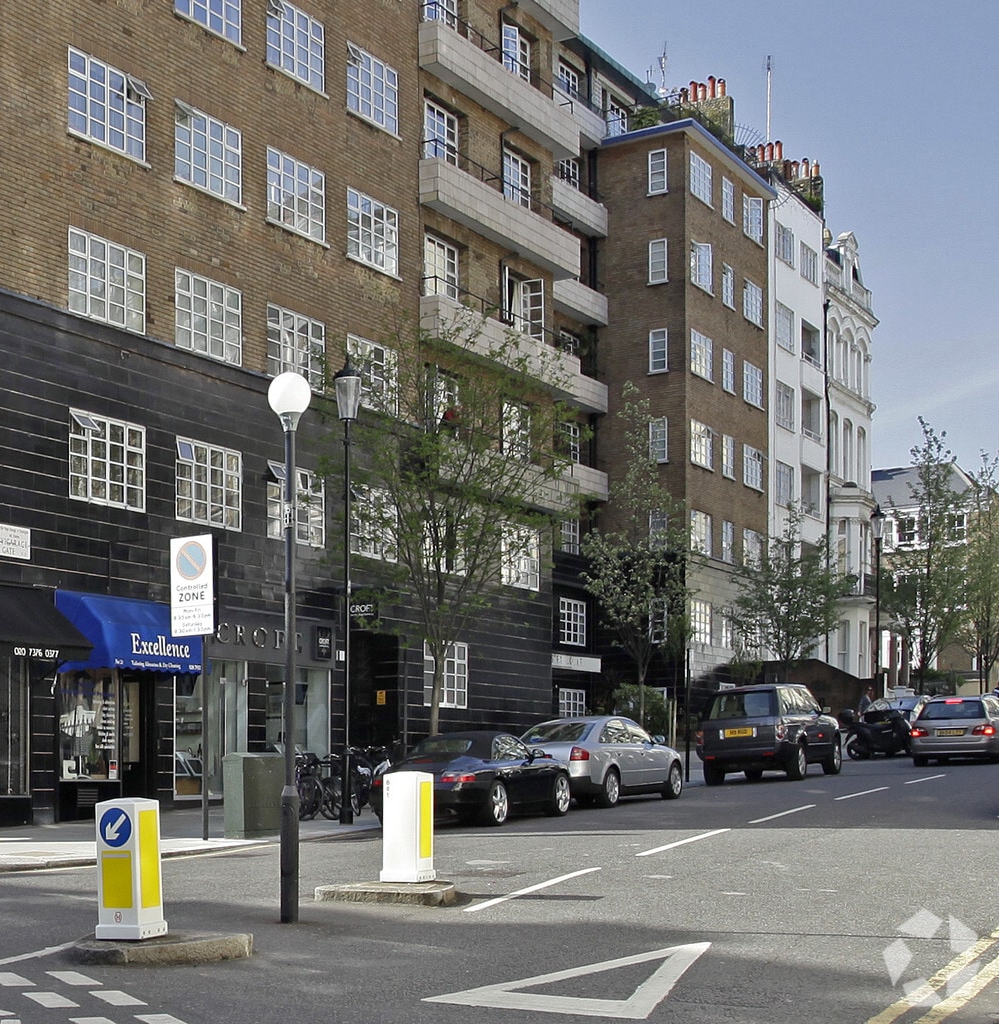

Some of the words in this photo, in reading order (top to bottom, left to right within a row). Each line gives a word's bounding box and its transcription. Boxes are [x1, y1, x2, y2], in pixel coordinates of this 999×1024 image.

[176, 583, 208, 592] Controlled
[179, 591, 205, 602] ZONE
[216, 622, 302, 651] CROFT
[130, 632, 191, 658] Excellence
[14, 646, 26, 657] 020
[29, 647, 43, 658] 7376
[45, 649, 59, 659] 0377
